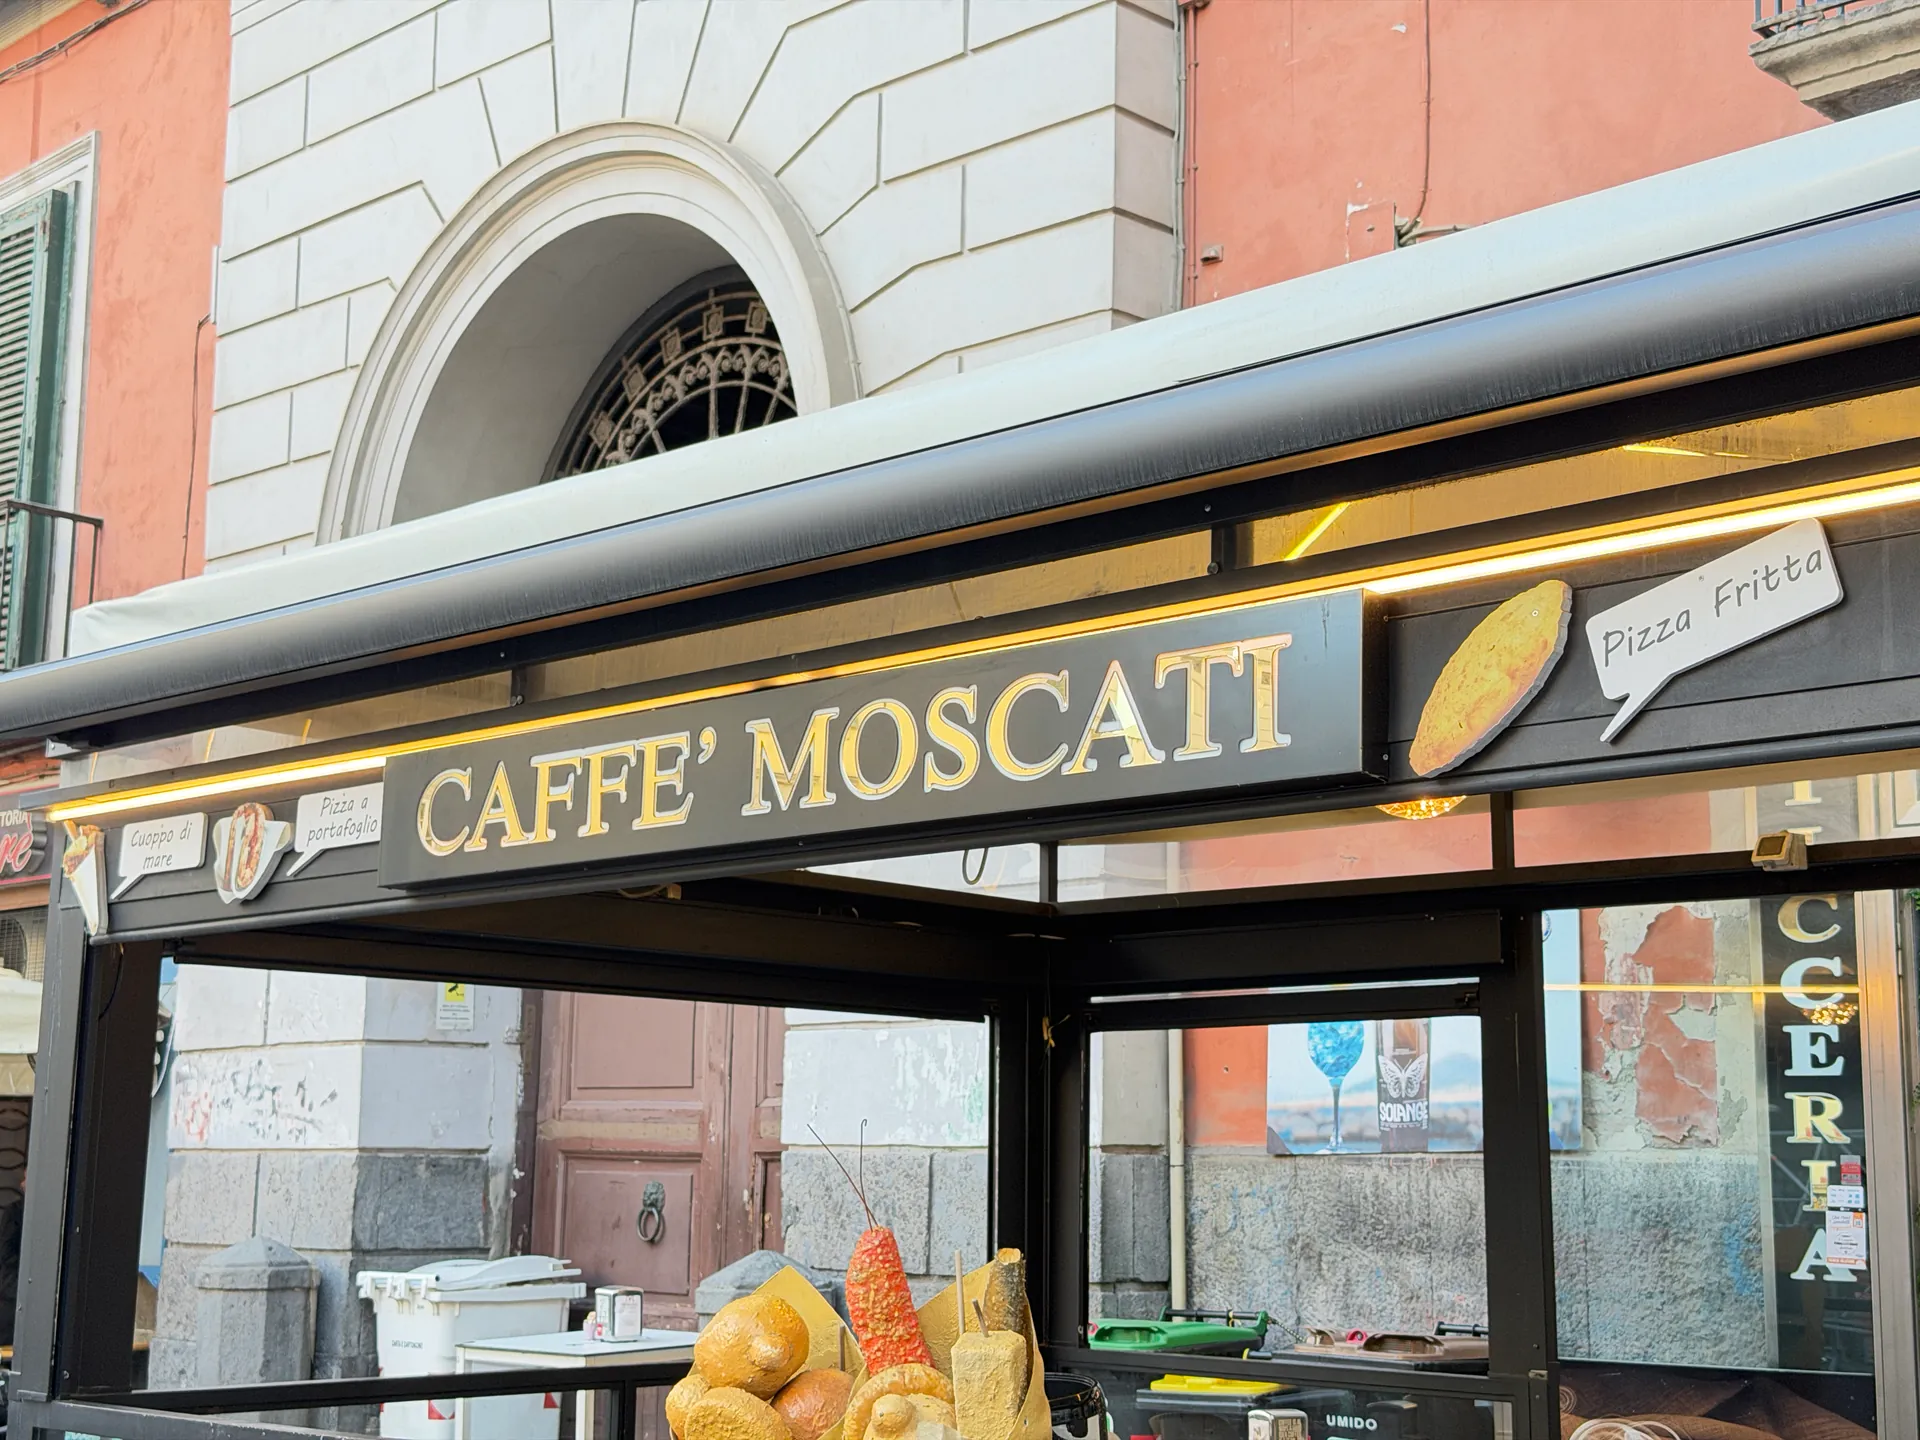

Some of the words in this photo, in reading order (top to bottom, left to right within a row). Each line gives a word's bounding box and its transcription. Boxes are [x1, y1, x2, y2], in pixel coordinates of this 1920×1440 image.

[1603, 609, 1691, 667] Pizza
[1714, 549, 1823, 617] Fritta
[416, 726, 717, 857] CAFFE'
[741, 633, 1293, 816] MOSCATI
[320, 795, 354, 817] Pizza
[361, 797, 369, 810] a
[131, 829, 174, 850] Cuoppo
[180, 820, 193, 840] di
[307, 814, 378, 845] portafoglio
[143, 856, 172, 870] mare
[1777, 779, 1858, 1282] CCERIA
[1379, 1101, 1428, 1122] SOLANGE
[1326, 1414, 1378, 1431] UMIDO
